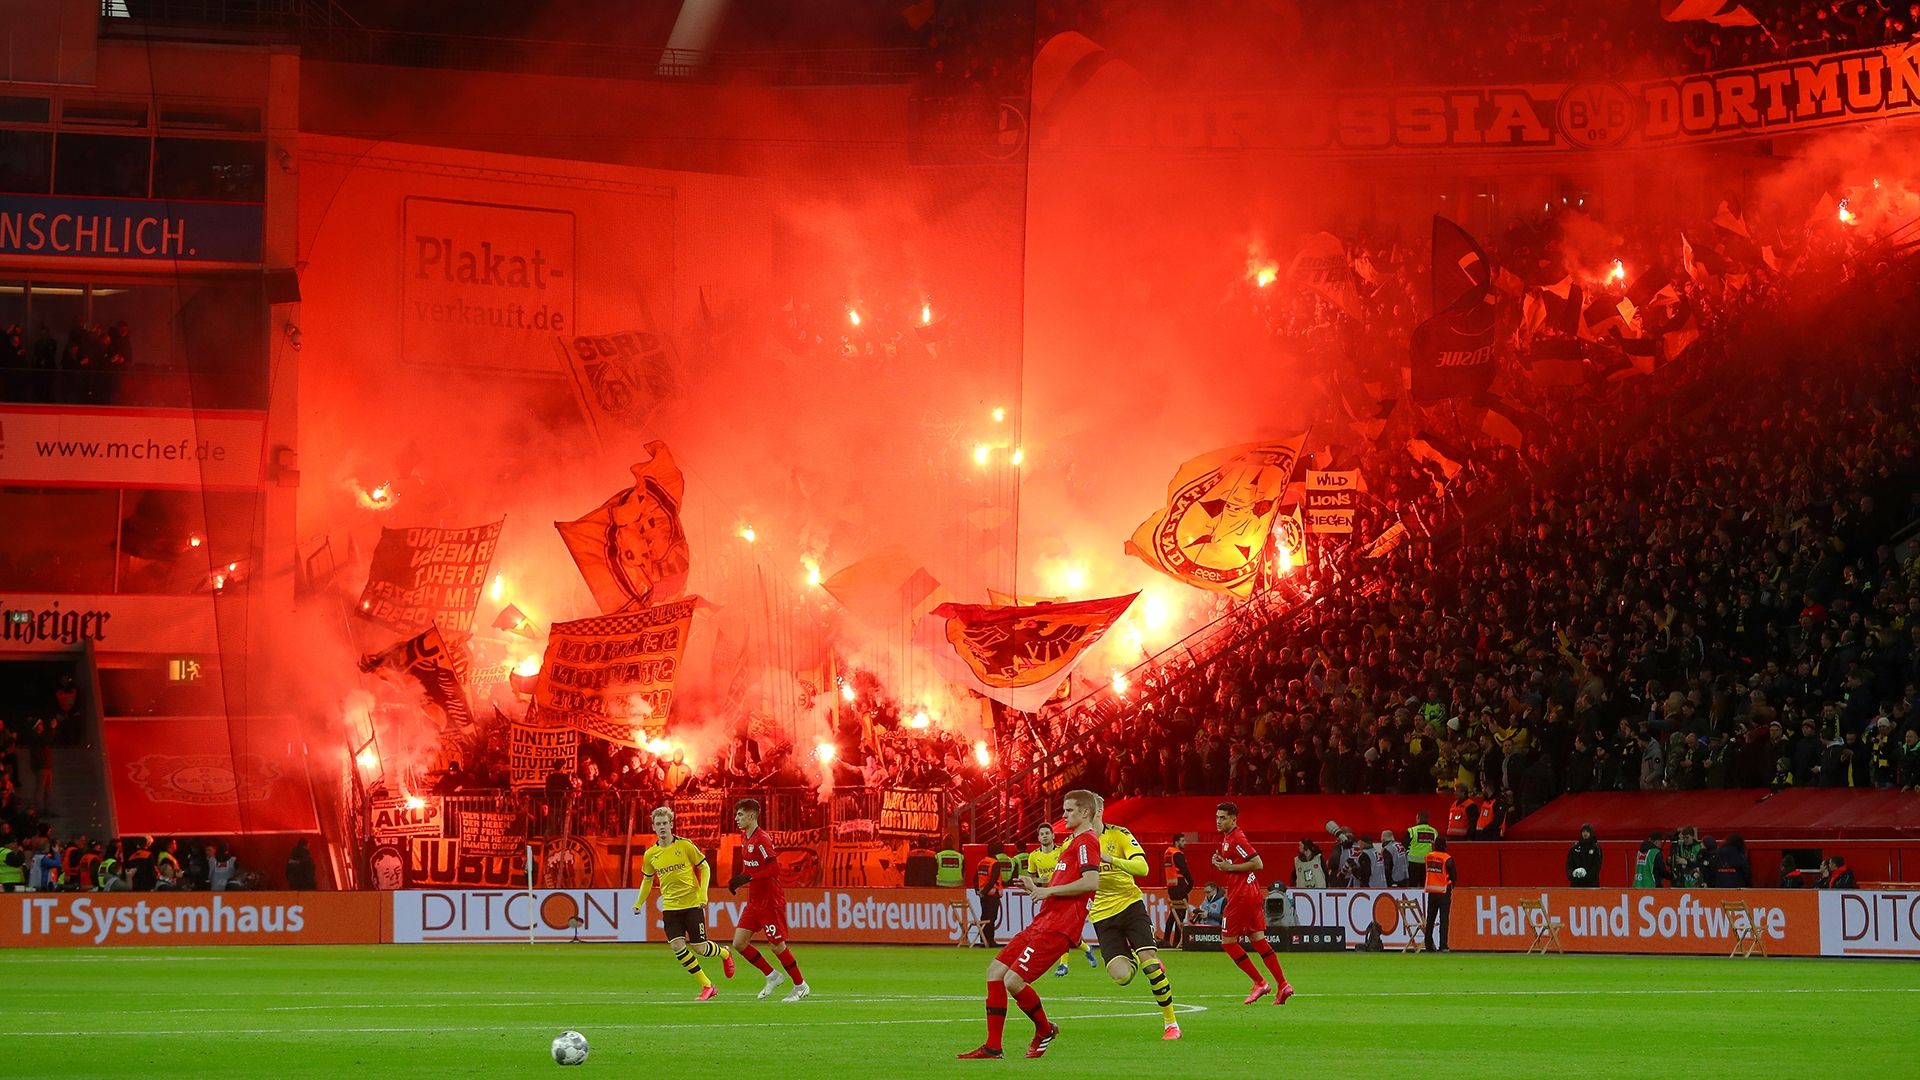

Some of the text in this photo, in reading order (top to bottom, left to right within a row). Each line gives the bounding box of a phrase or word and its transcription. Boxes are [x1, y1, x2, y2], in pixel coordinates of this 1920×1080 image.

[1569, 87, 1626, 129] BVB
[1587, 130, 1608, 141] 09
[0, 212, 196, 256] NSCHLICH.
[416, 235, 564, 289] Plakat-
[414, 299, 564, 331] verkauft.de
[36, 439, 225, 461] www.mchef.de
[1317, 473, 1348, 486] WILD
[1310, 493, 1351, 506] LIONS
[1306, 514, 1353, 526] SIEGEN
[0, 601, 111, 645] nzeiger
[513, 728, 576, 747] UNITED
[513, 745, 575, 758] WE STAND
[512, 757, 575, 770] DIVIDD
[512, 769, 535, 781] WE
[883, 790, 939, 812] HOOLIGANS
[374, 805, 438, 828] AKLP
[461, 812, 517, 822] DER FREUND
[462, 820, 511, 829] DER NEBEN
[880, 809, 940, 831] DORTMUND
[462, 827, 506, 836] MIR FEHLT
[463, 834, 477, 842] IST
[479, 835, 489, 843] IM
[463, 841, 490, 850] IMMER
[22, 896, 304, 944] IT-Systemhaus
[422, 892, 618, 930] DITCON
[787, 892, 831, 930] und
[838, 892, 963, 940] Betreuung
[1293, 892, 1427, 936] DITCON
[1476, 893, 1787, 939] Hard- und Software
[1018, 947, 1035, 963] 5
